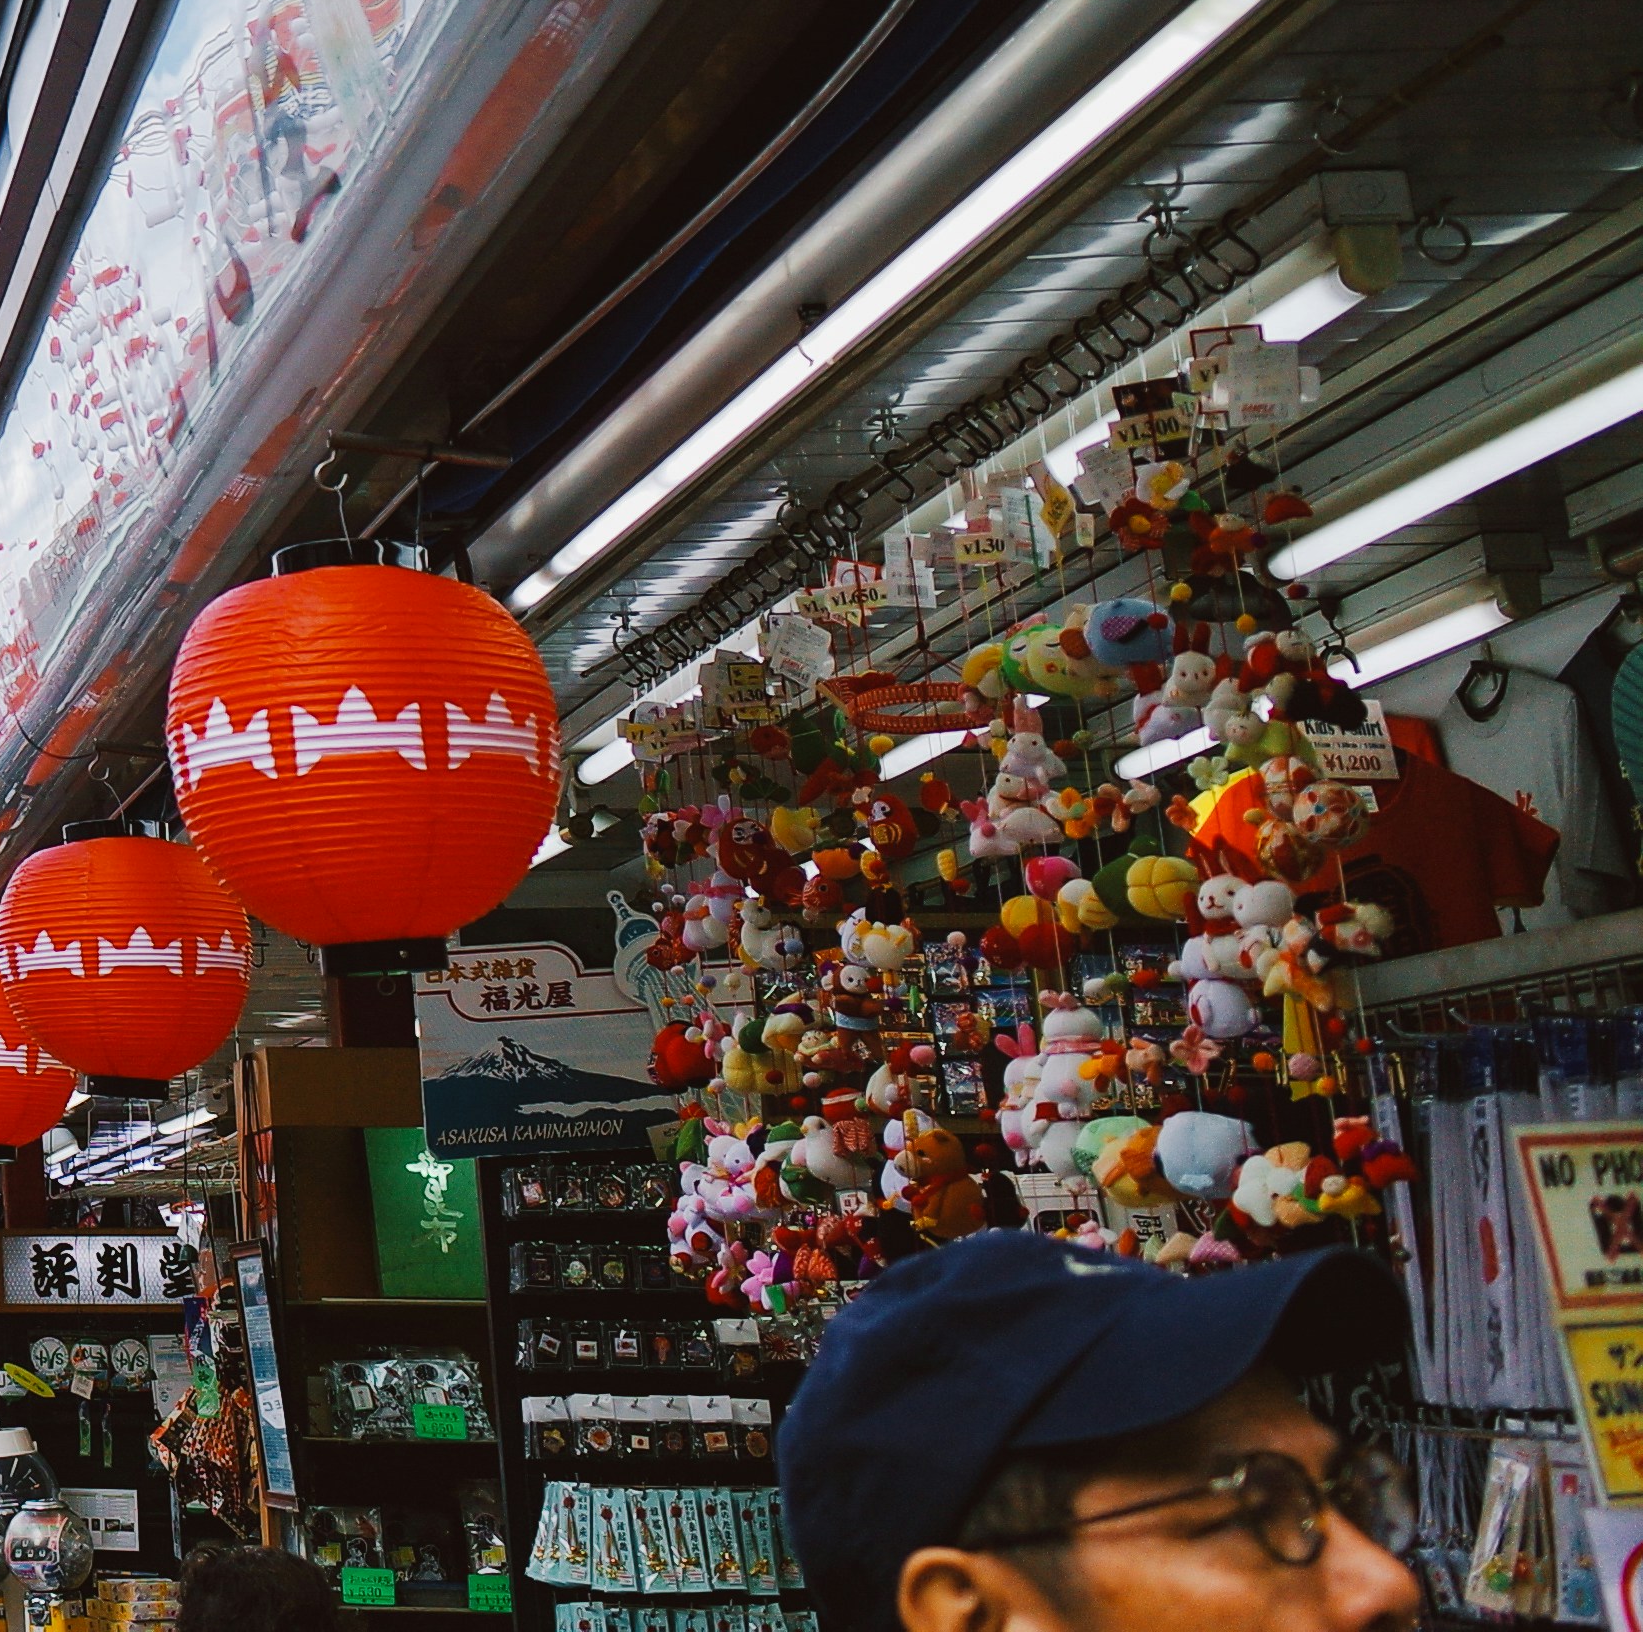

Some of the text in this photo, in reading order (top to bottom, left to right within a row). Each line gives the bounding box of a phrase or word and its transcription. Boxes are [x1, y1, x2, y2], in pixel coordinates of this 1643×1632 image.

[1323, 753, 1382, 772] ¥1,200
[479, 980, 577, 1013] 福光屋
[435, 1118, 625, 1147] ASAKUSA KAMINARIMON
[1539, 1154, 1575, 1188] NO
[29, 1242, 196, 1299] 評判堂
